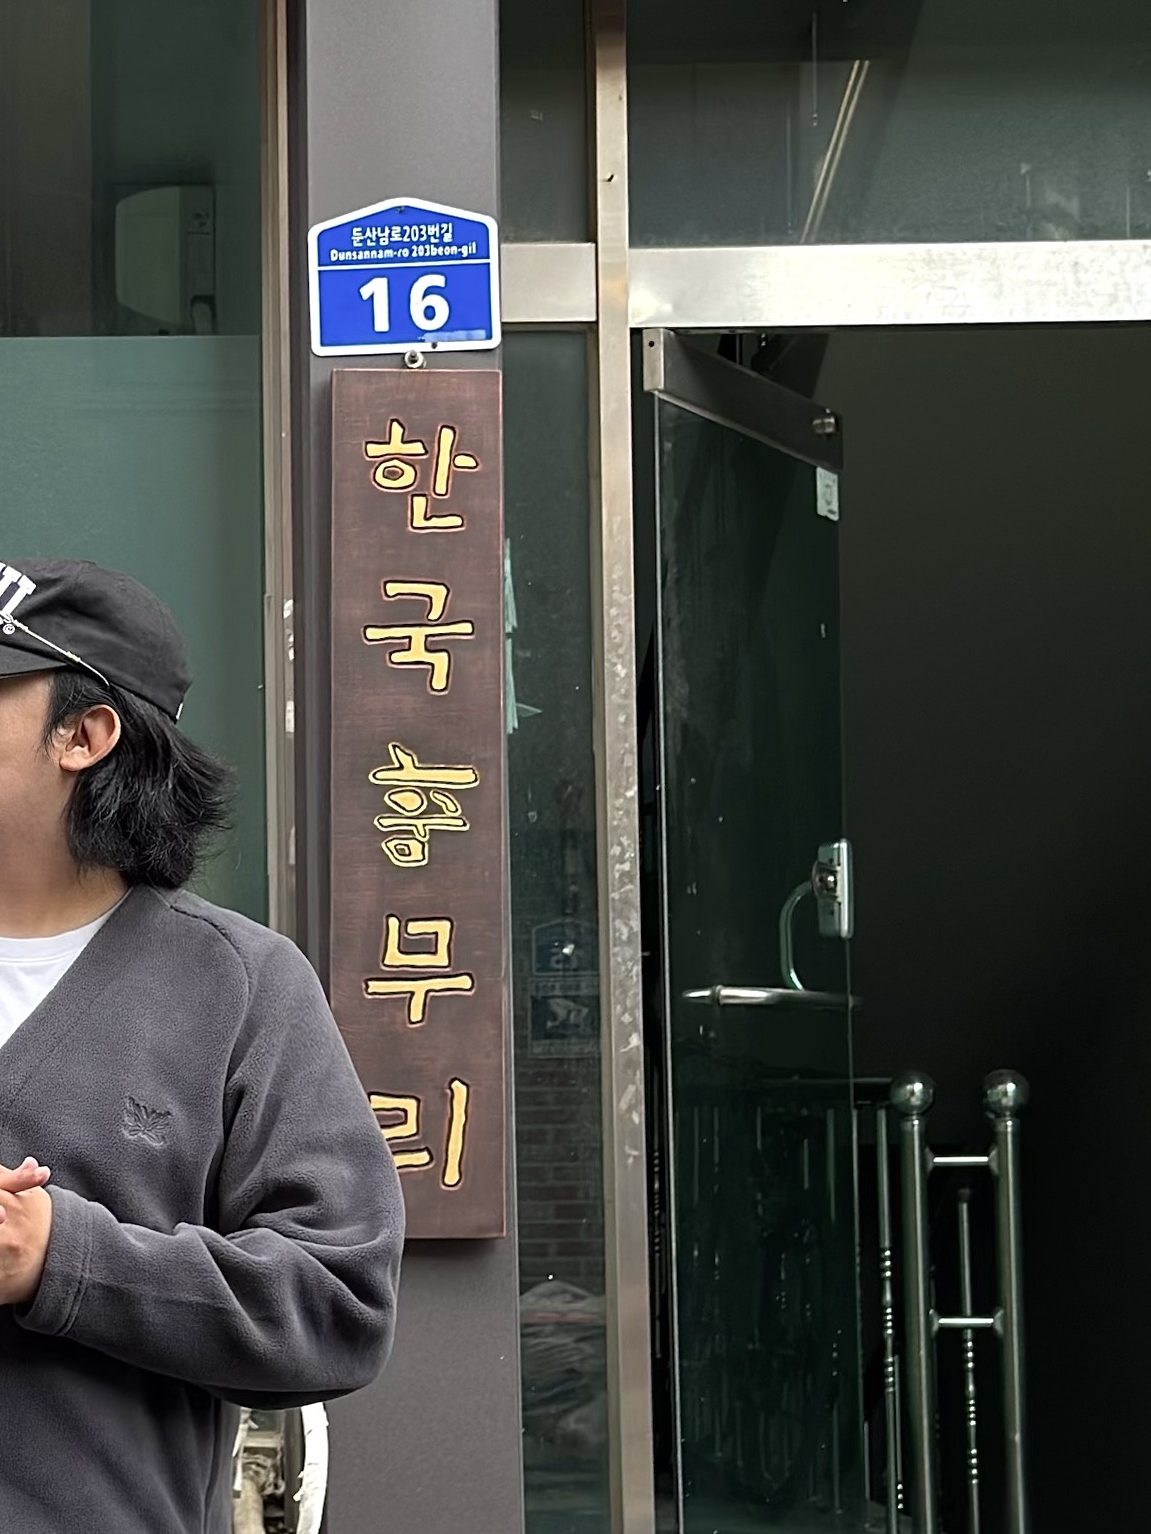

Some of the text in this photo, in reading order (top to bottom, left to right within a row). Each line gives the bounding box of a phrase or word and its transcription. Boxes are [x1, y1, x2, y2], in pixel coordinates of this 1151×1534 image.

[351, 222, 453, 247] 둔산남로203번길
[330, 241, 476, 262] Dunsannam-ro 203beon-gil
[359, 273, 450, 332] 16
